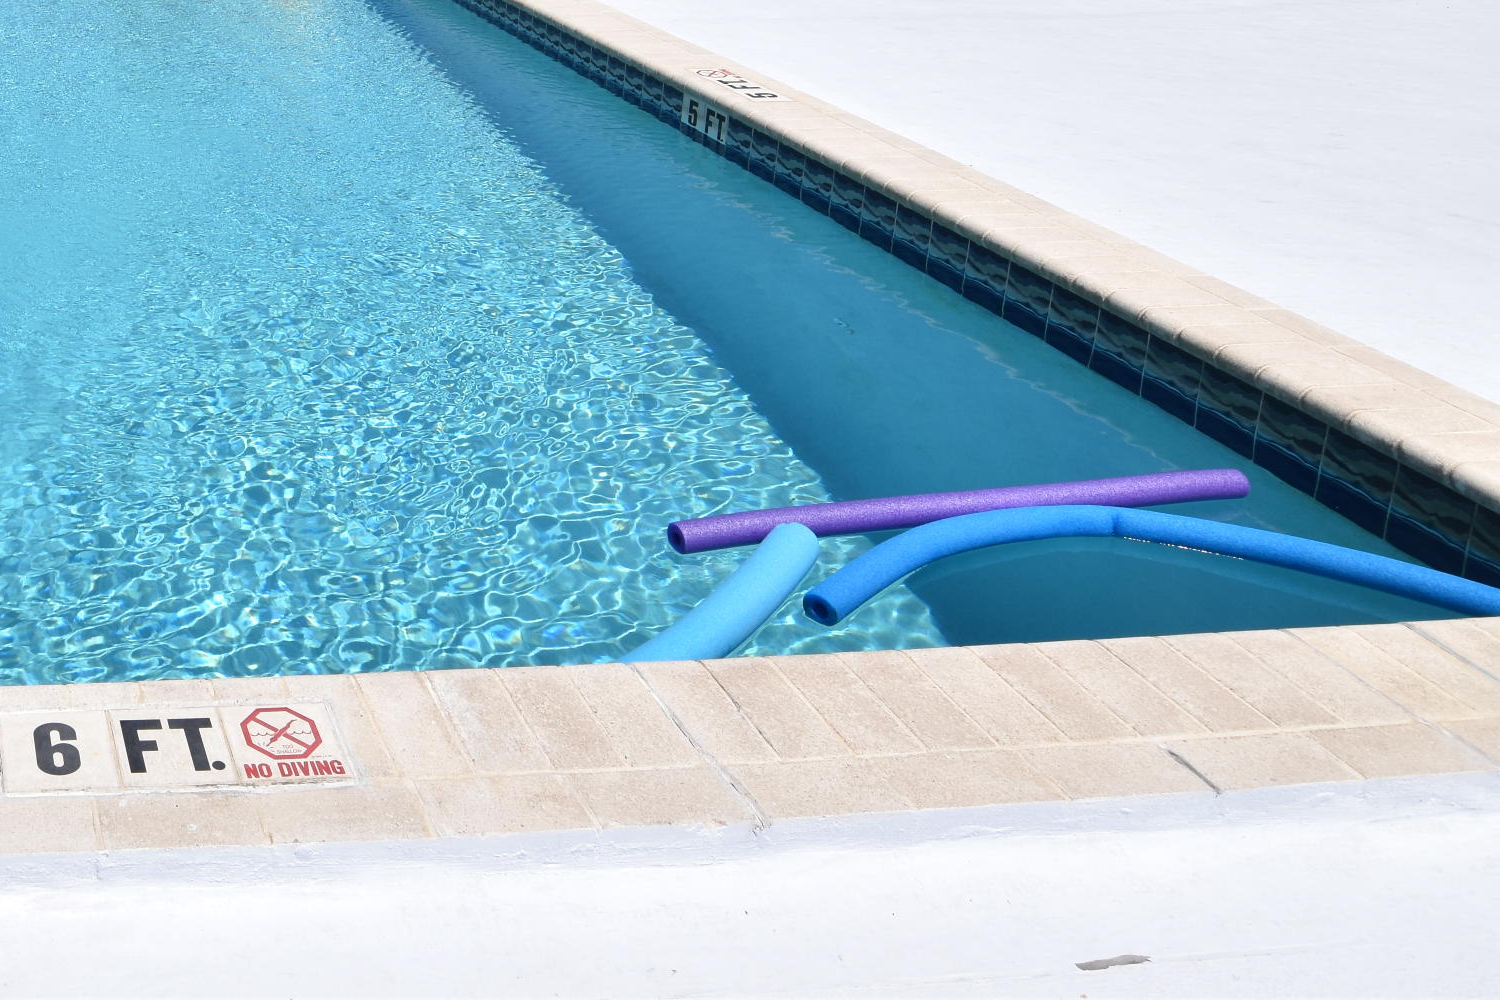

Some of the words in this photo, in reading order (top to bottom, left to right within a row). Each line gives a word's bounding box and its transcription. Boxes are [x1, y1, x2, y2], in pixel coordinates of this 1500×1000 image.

[688, 99, 698, 126] 5
[33, 722, 82, 776] 6
[120, 717, 226, 774] FT.
[244, 763, 273, 778] NO
[277, 760, 346, 777] DIVING
